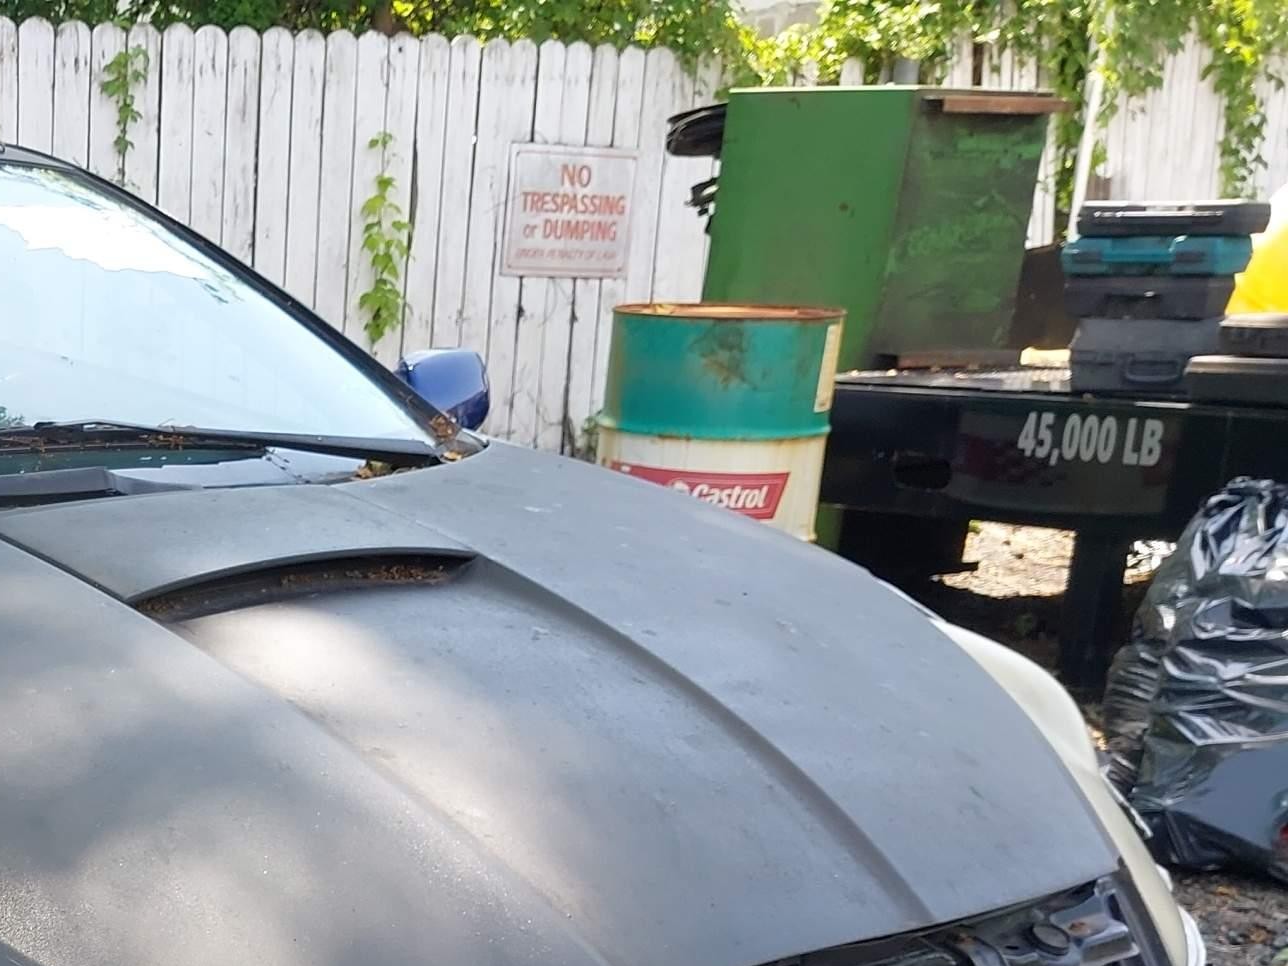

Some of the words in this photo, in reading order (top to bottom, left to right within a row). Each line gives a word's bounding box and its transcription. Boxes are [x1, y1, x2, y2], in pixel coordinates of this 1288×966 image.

[560, 164, 592, 188] NO
[522, 192, 626, 216] TRESPASSING
[523, 223, 538, 239] or
[543, 219, 617, 242] DUMPING
[1017, 411, 1117, 466] 45,000
[1122, 418, 1164, 466] LB
[692, 484, 769, 508] Castrol
